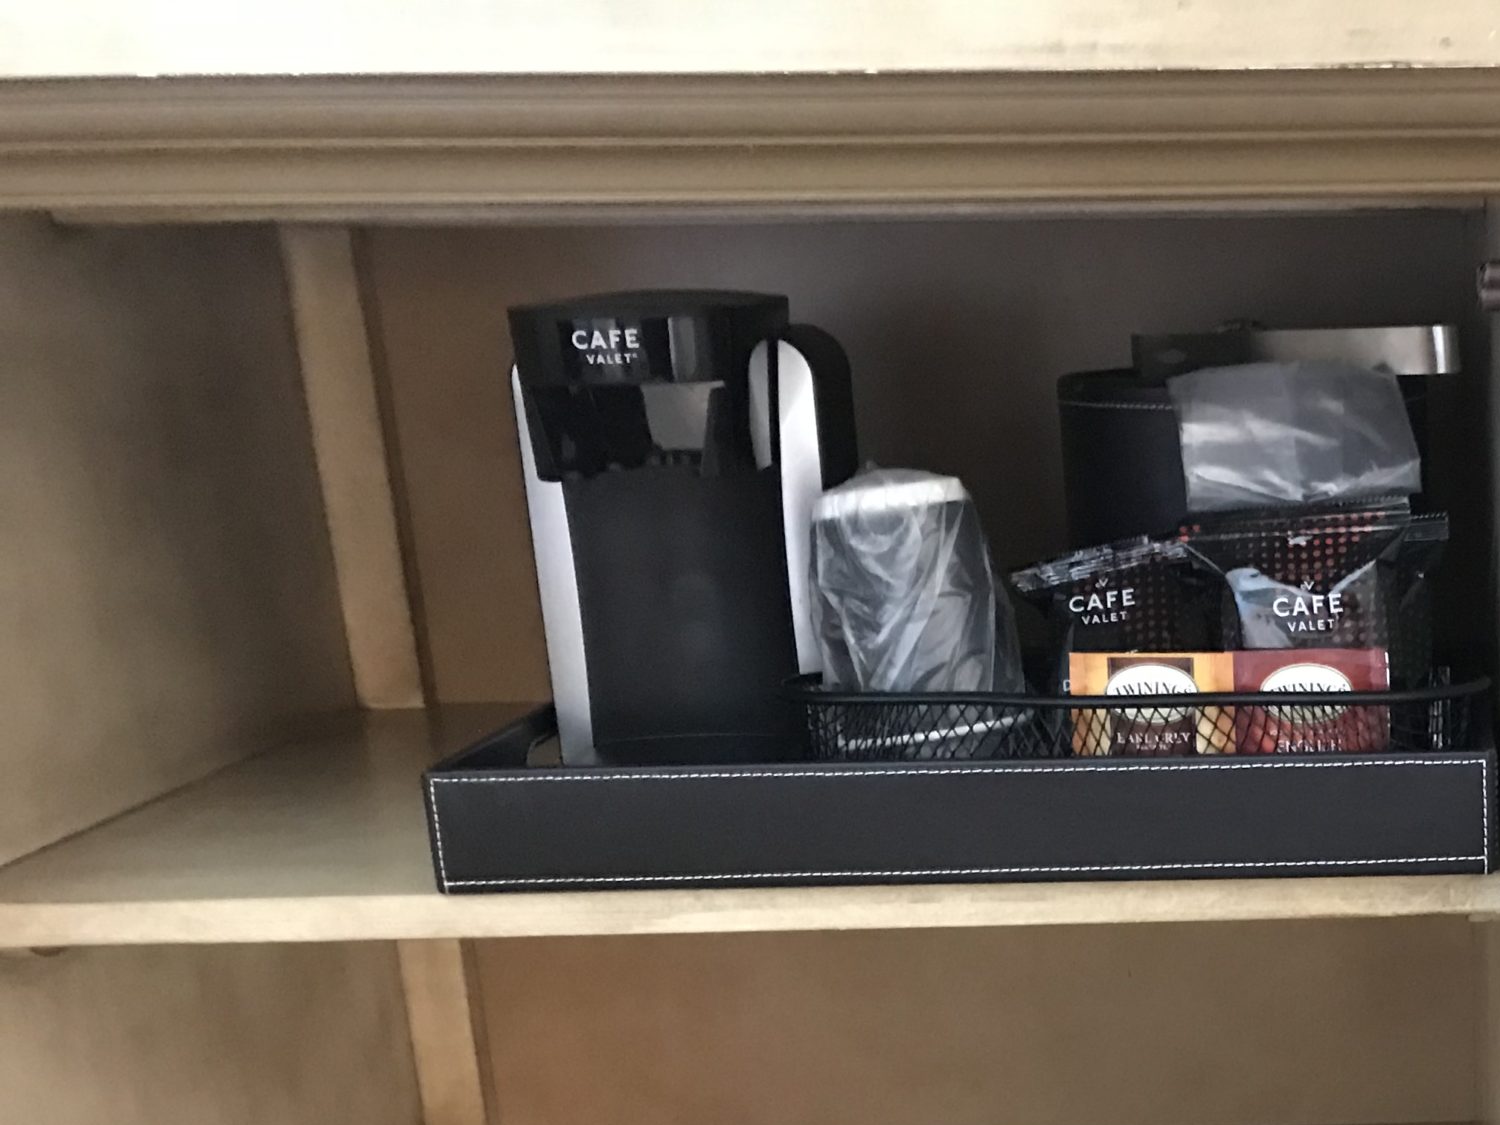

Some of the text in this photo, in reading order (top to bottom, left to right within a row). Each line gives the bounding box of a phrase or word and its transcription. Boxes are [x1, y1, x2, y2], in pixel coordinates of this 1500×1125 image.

[571, 328, 640, 350] CAFE
[586, 353, 632, 365] VALET
[1069, 588, 1136, 612] CAFE
[1272, 593, 1344, 617] CAFE
[1081, 611, 1127, 625] VALET
[1287, 619, 1335, 632] VALET
